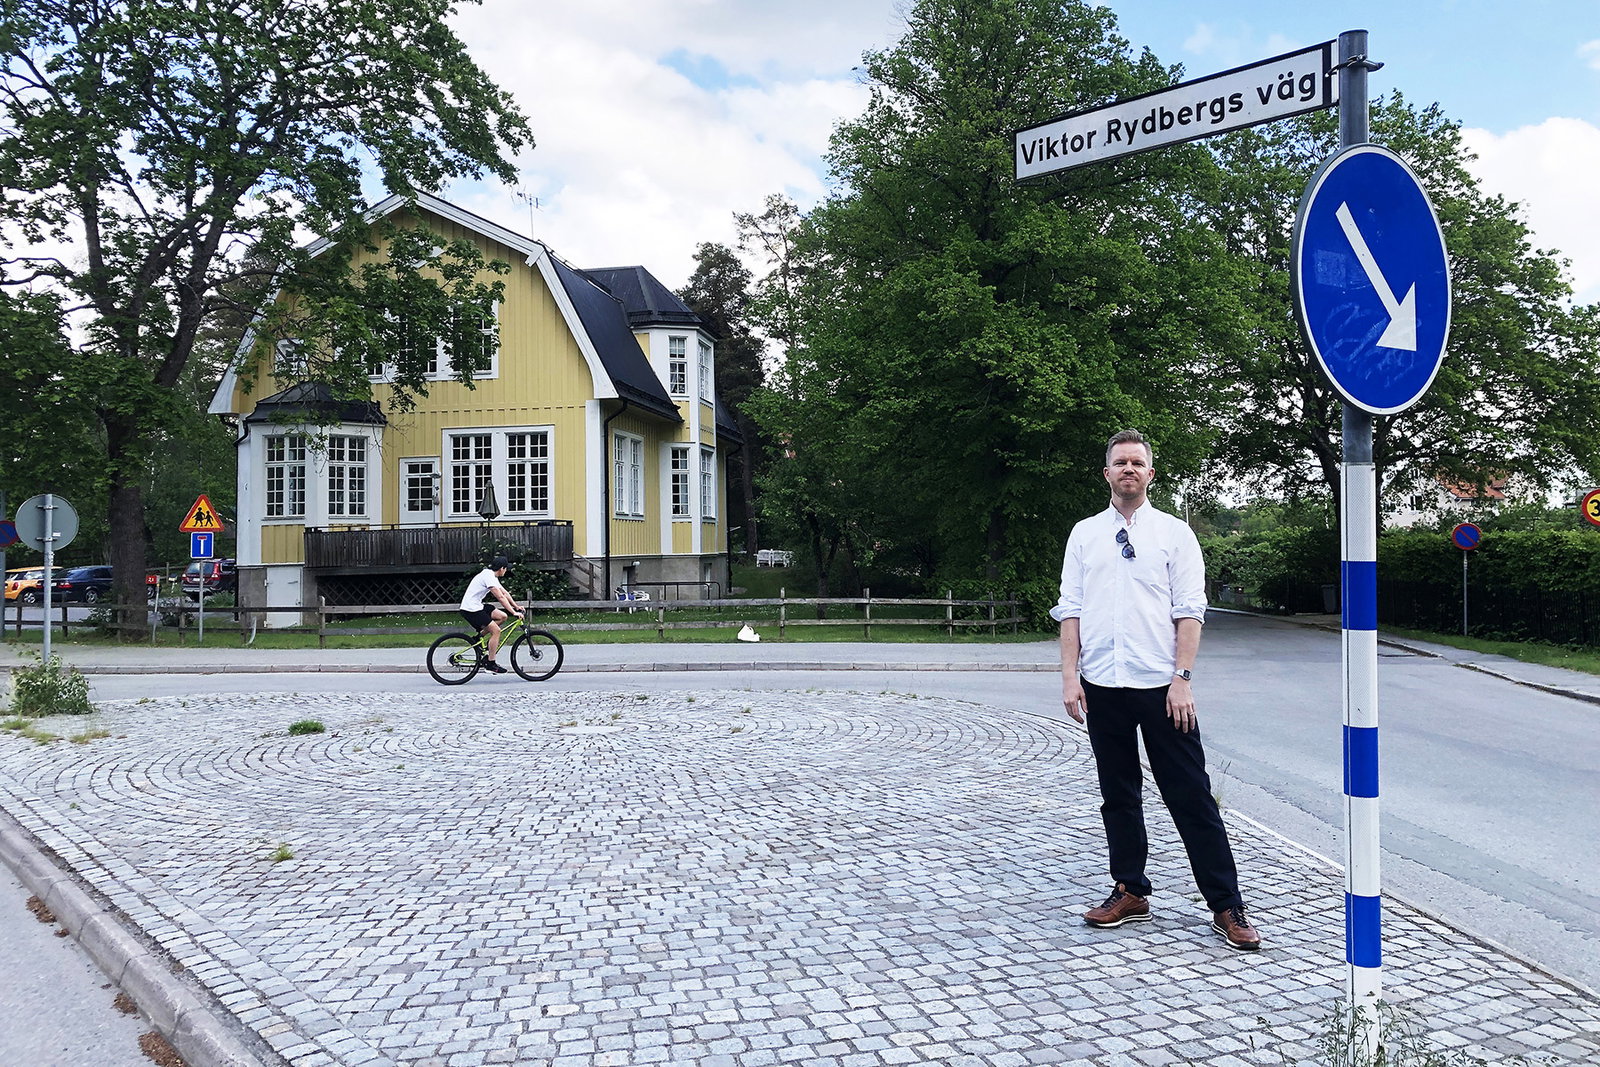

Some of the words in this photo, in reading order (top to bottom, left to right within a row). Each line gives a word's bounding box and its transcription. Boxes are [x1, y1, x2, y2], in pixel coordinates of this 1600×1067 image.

[1020, 130, 1097, 165] Viktor
[1106, 92, 1244, 146] Rydbergs
[1256, 70, 1316, 106] väg
